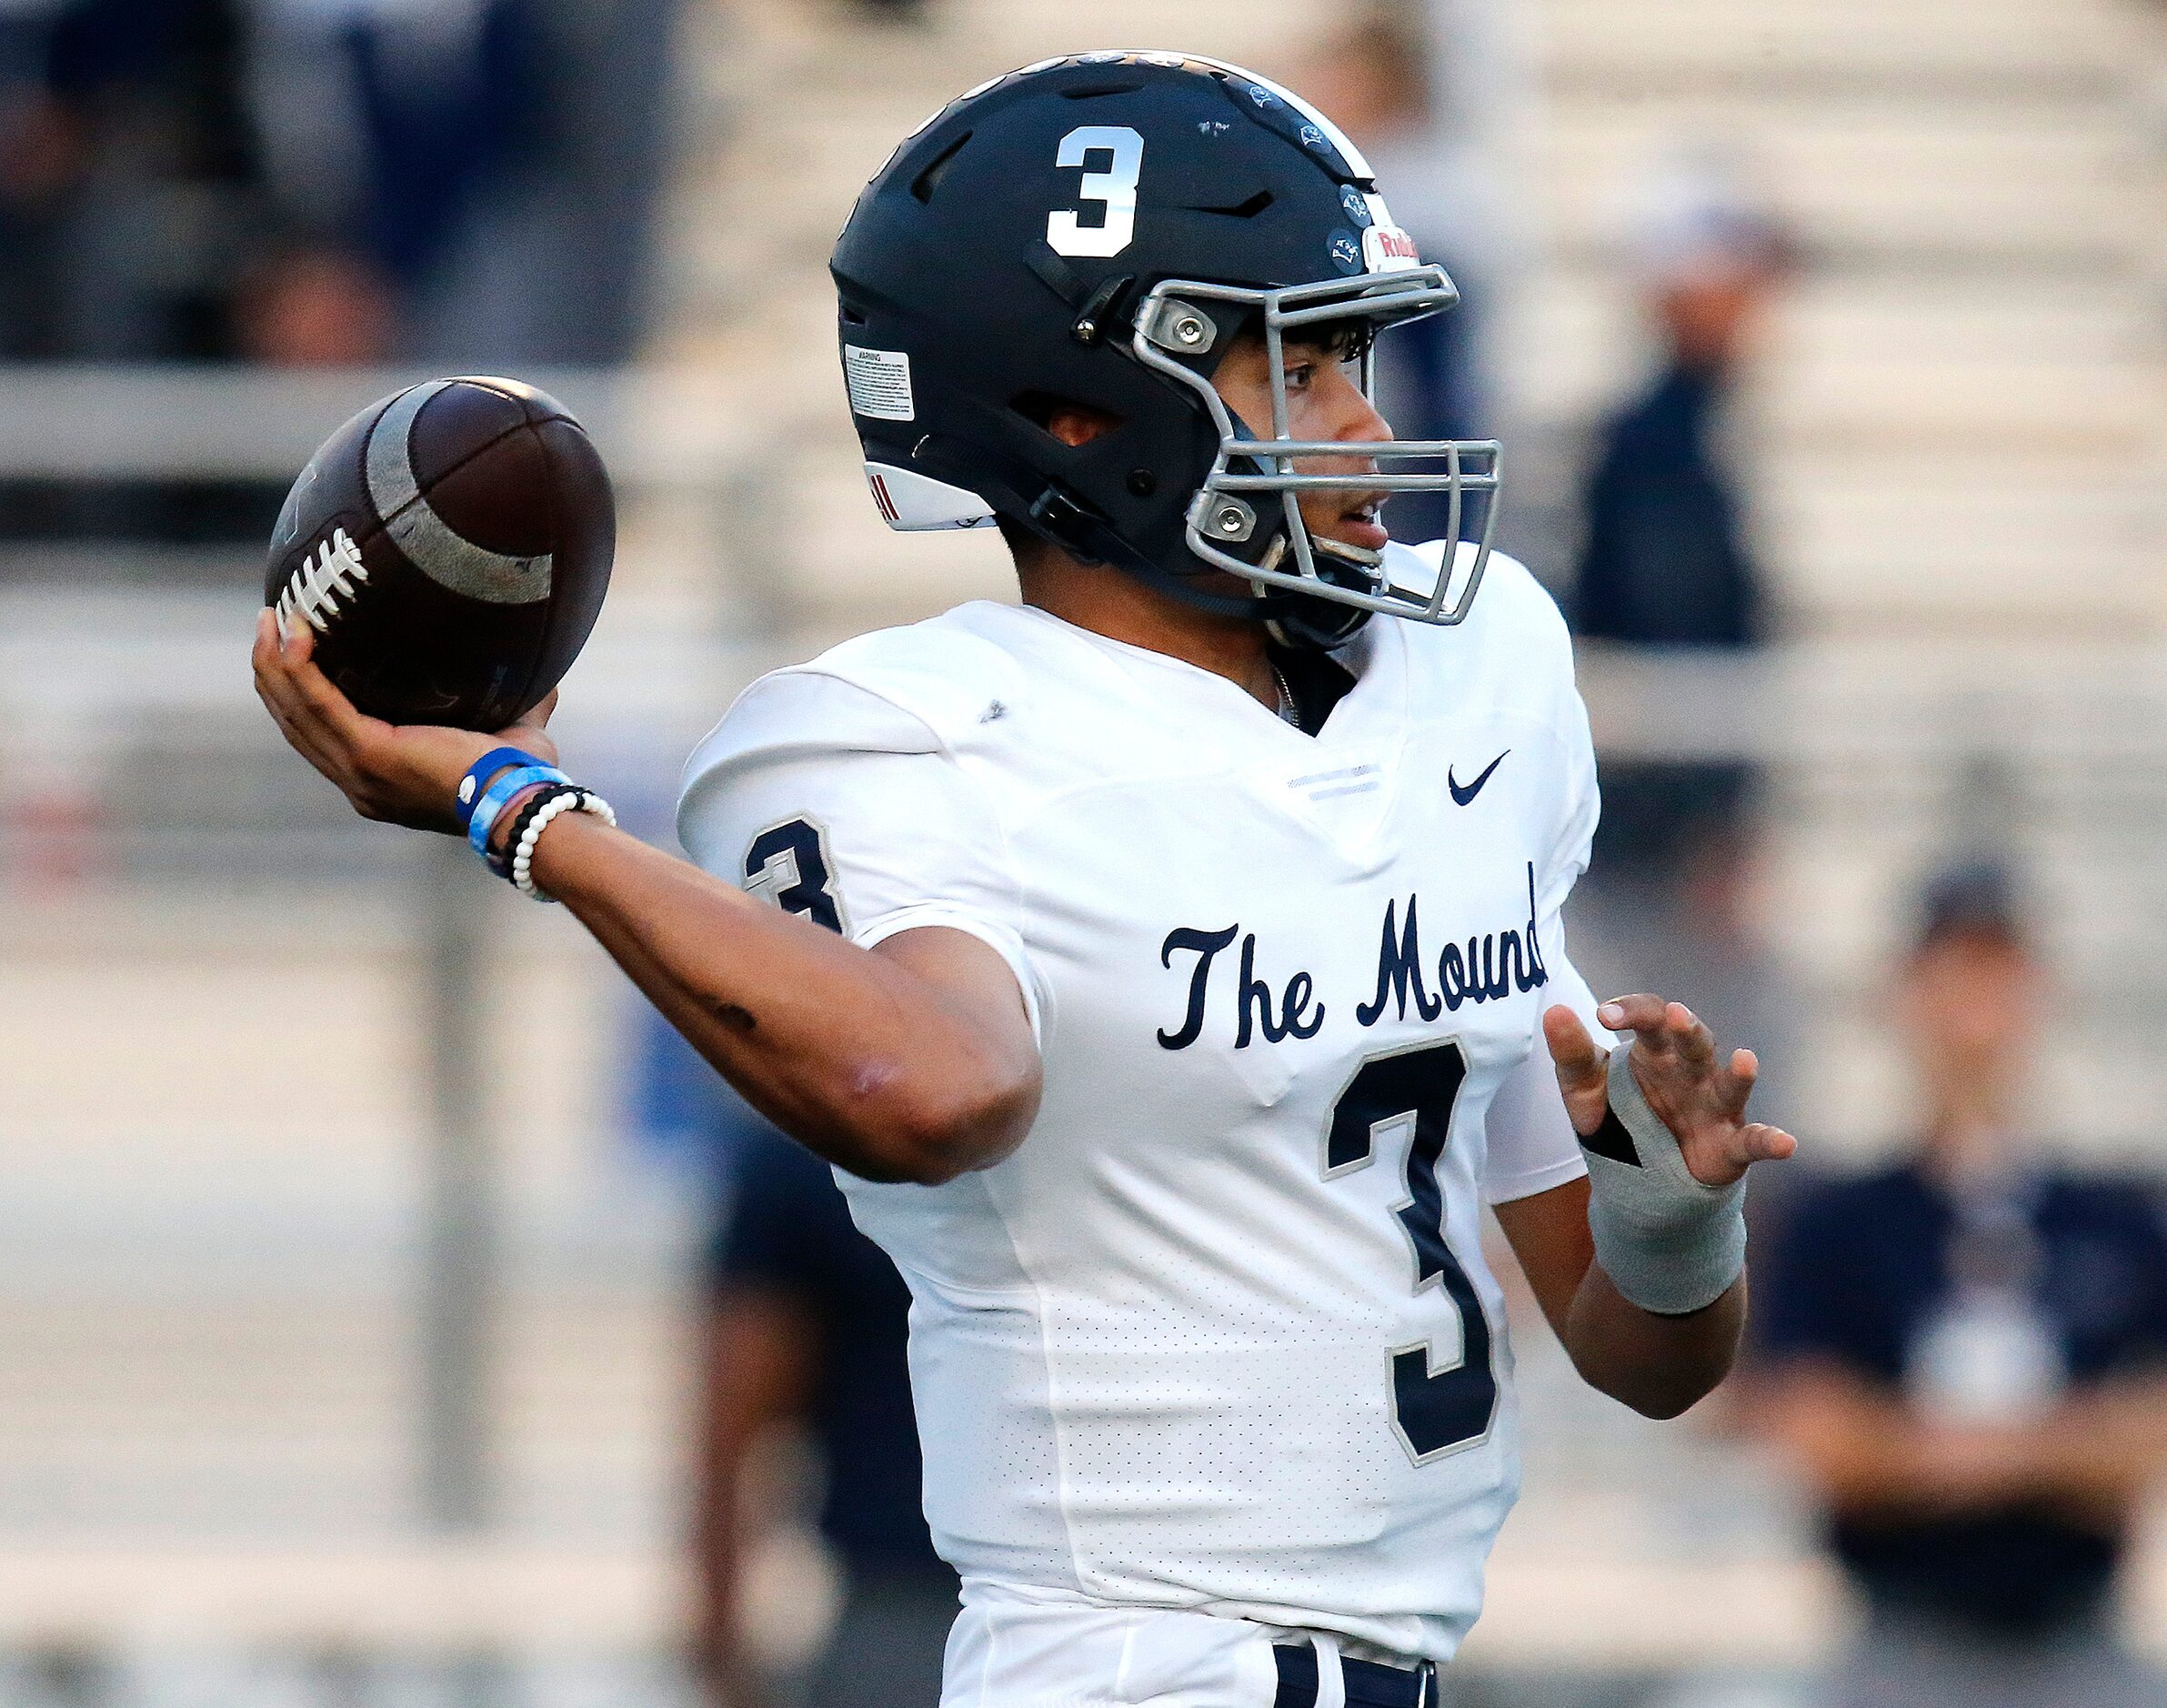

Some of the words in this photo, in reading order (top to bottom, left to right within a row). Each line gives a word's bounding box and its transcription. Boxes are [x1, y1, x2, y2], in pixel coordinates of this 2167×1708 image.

[1047, 126, 1145, 258] 3
[740, 809, 854, 940] 3
[1157, 922, 1325, 1050] The
[1356, 860, 1549, 1027] Mound
[1319, 1033, 1500, 1469] 3
